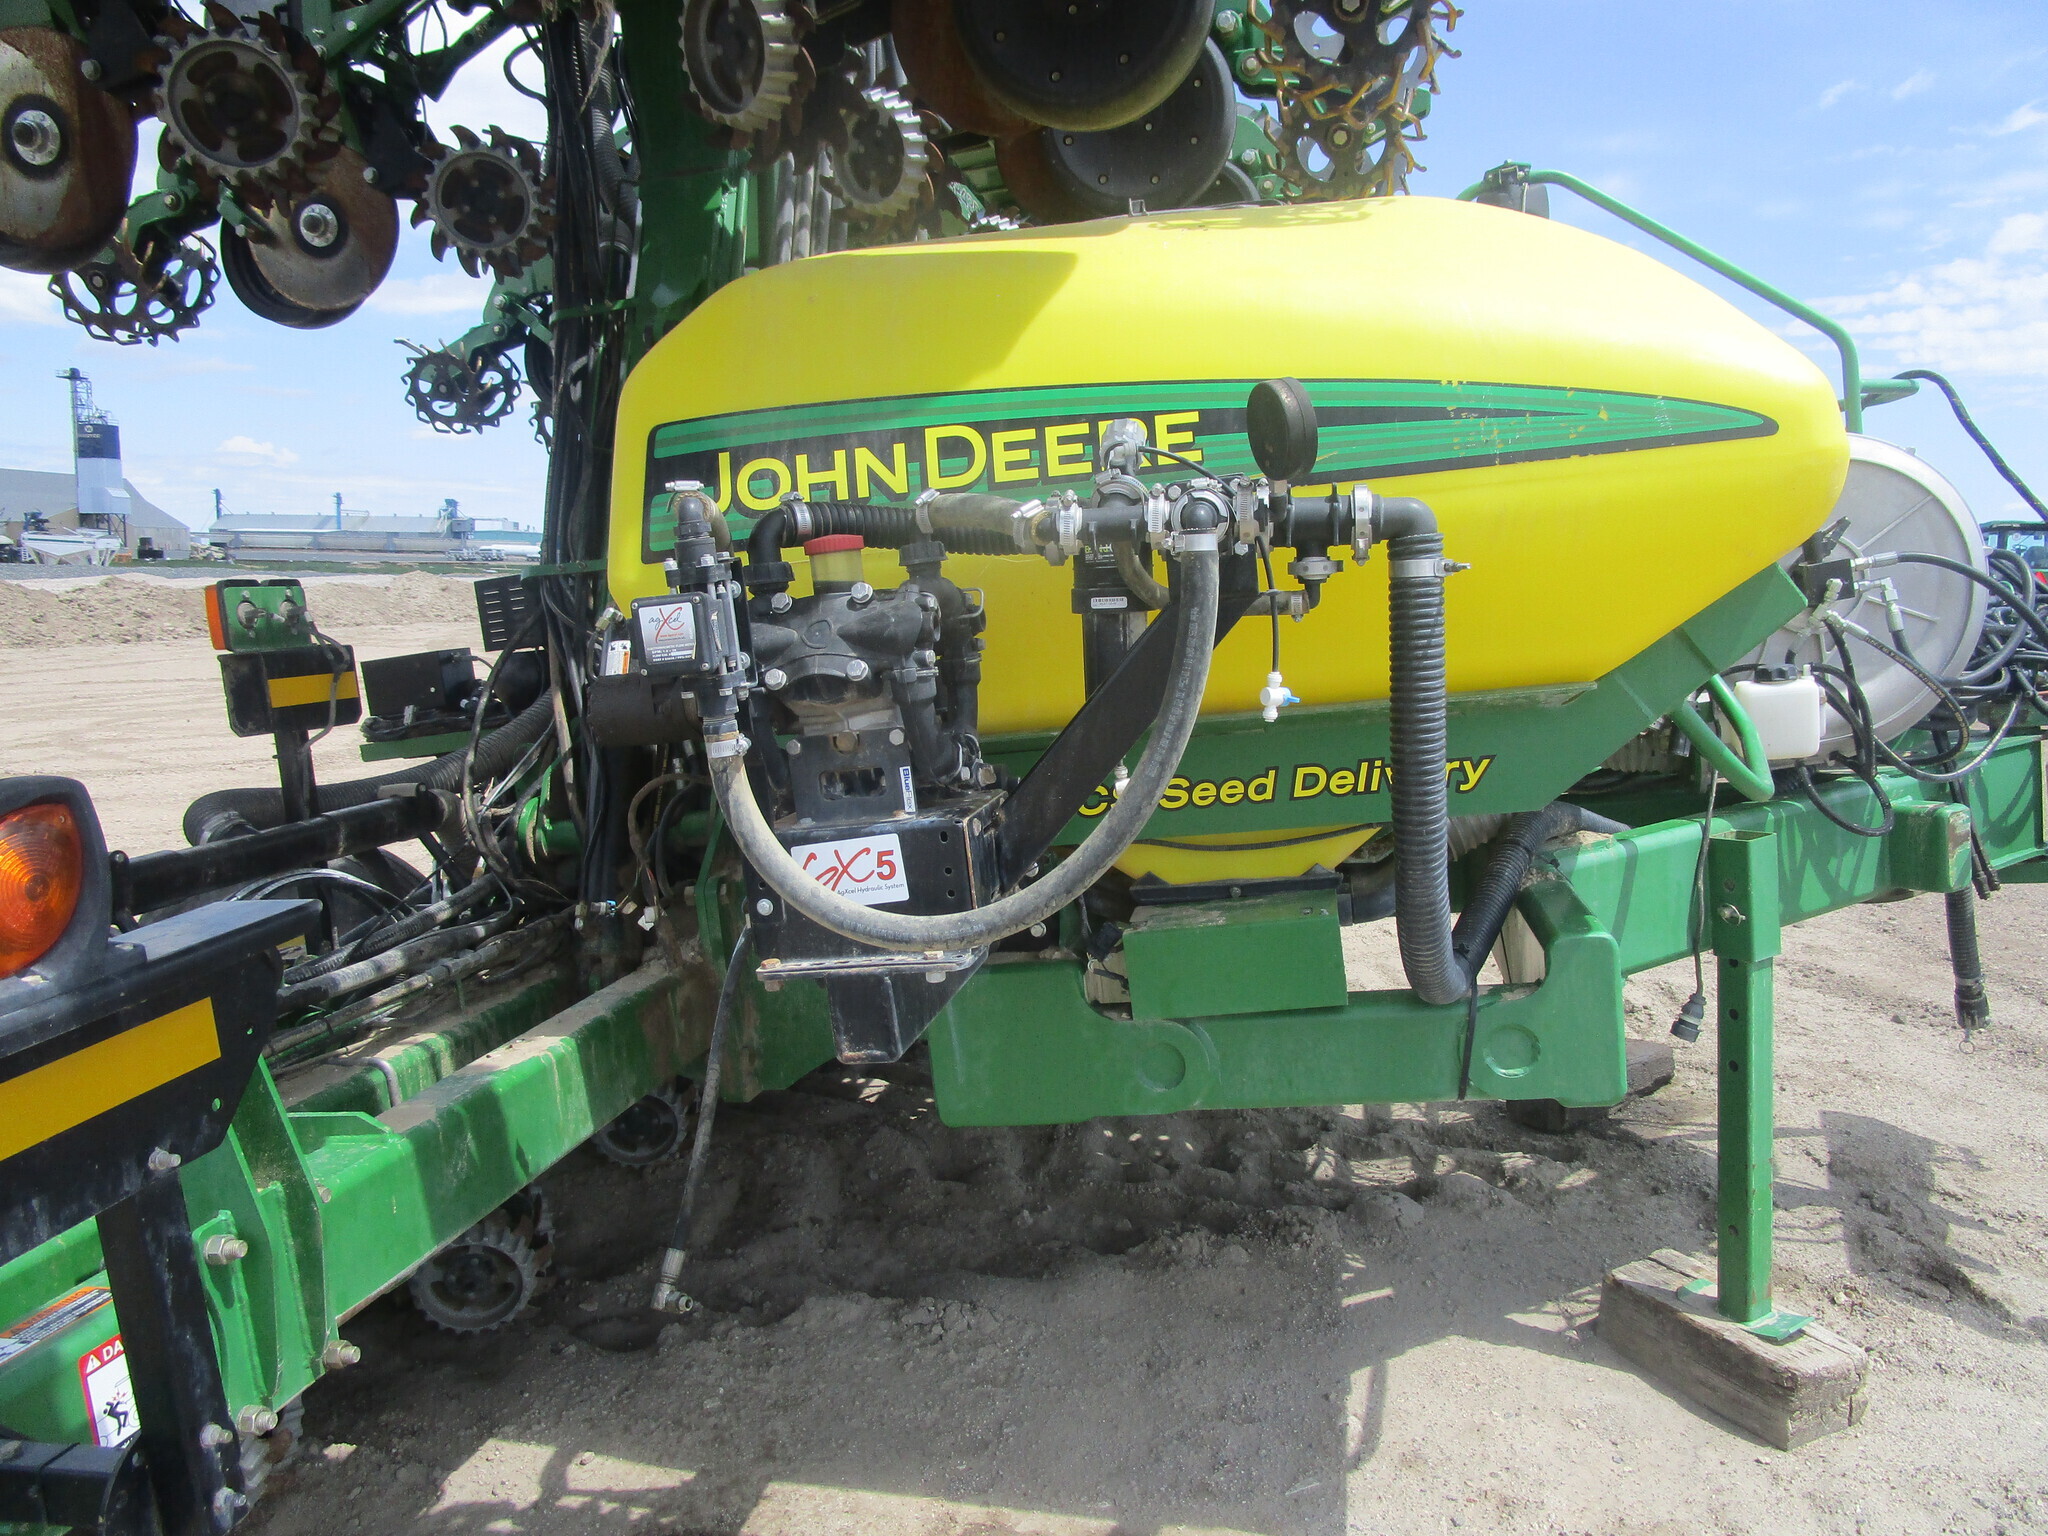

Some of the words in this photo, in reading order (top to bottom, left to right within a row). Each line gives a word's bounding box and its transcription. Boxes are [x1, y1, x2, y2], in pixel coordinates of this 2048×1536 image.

[716, 444, 908, 512] JOHN
[903, 768, 913, 810] BlueFlex
[1159, 769, 1276, 808] Seed
[1293, 758, 1491, 798] Deliry
